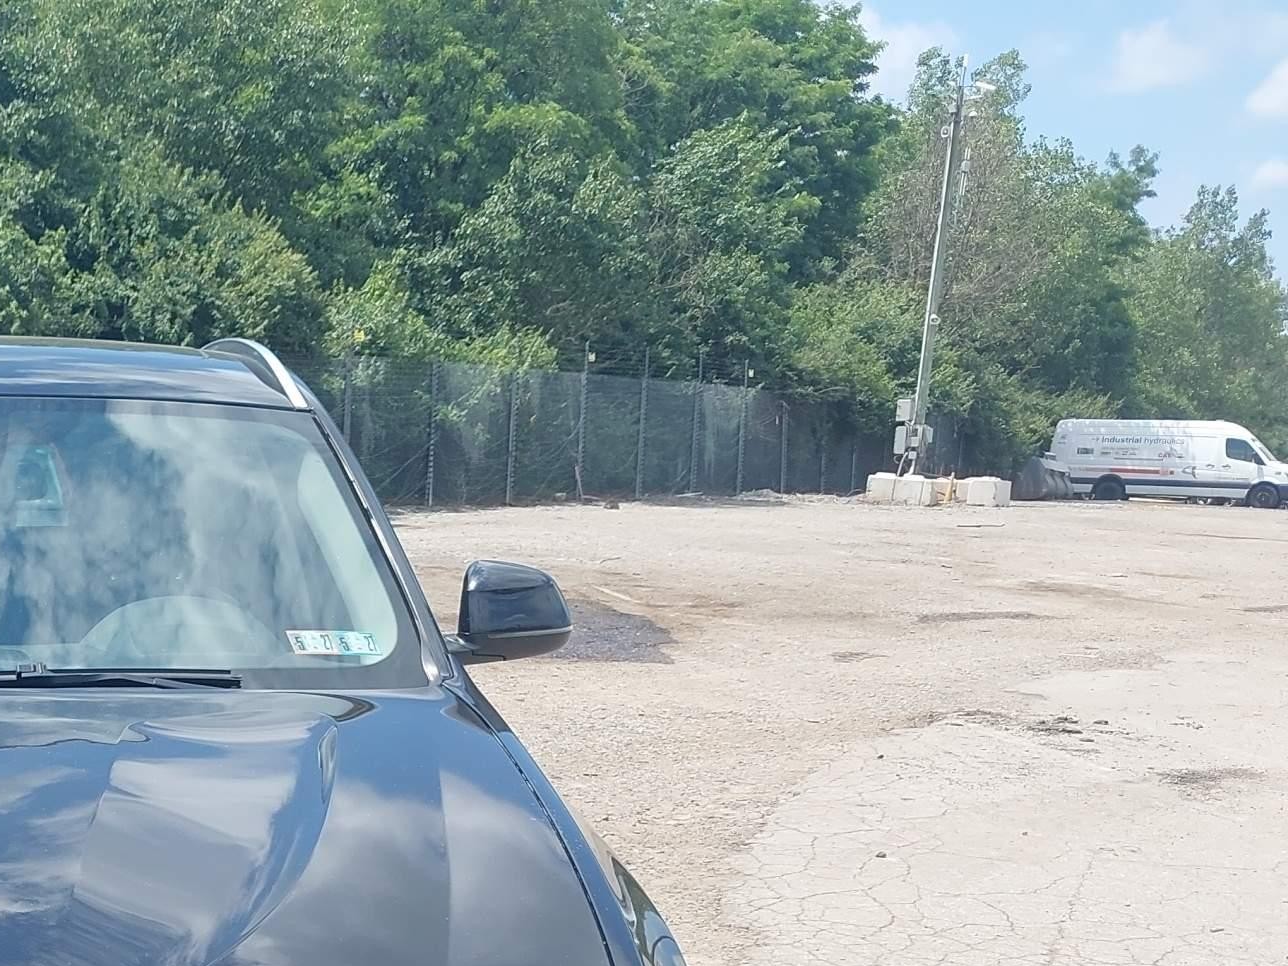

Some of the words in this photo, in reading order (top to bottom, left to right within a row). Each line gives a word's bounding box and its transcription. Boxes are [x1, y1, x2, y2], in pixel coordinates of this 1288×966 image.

[1101, 436, 1143, 444] Industrial
[295, 636, 305, 651] 5
[339, 637, 350, 651] 5
